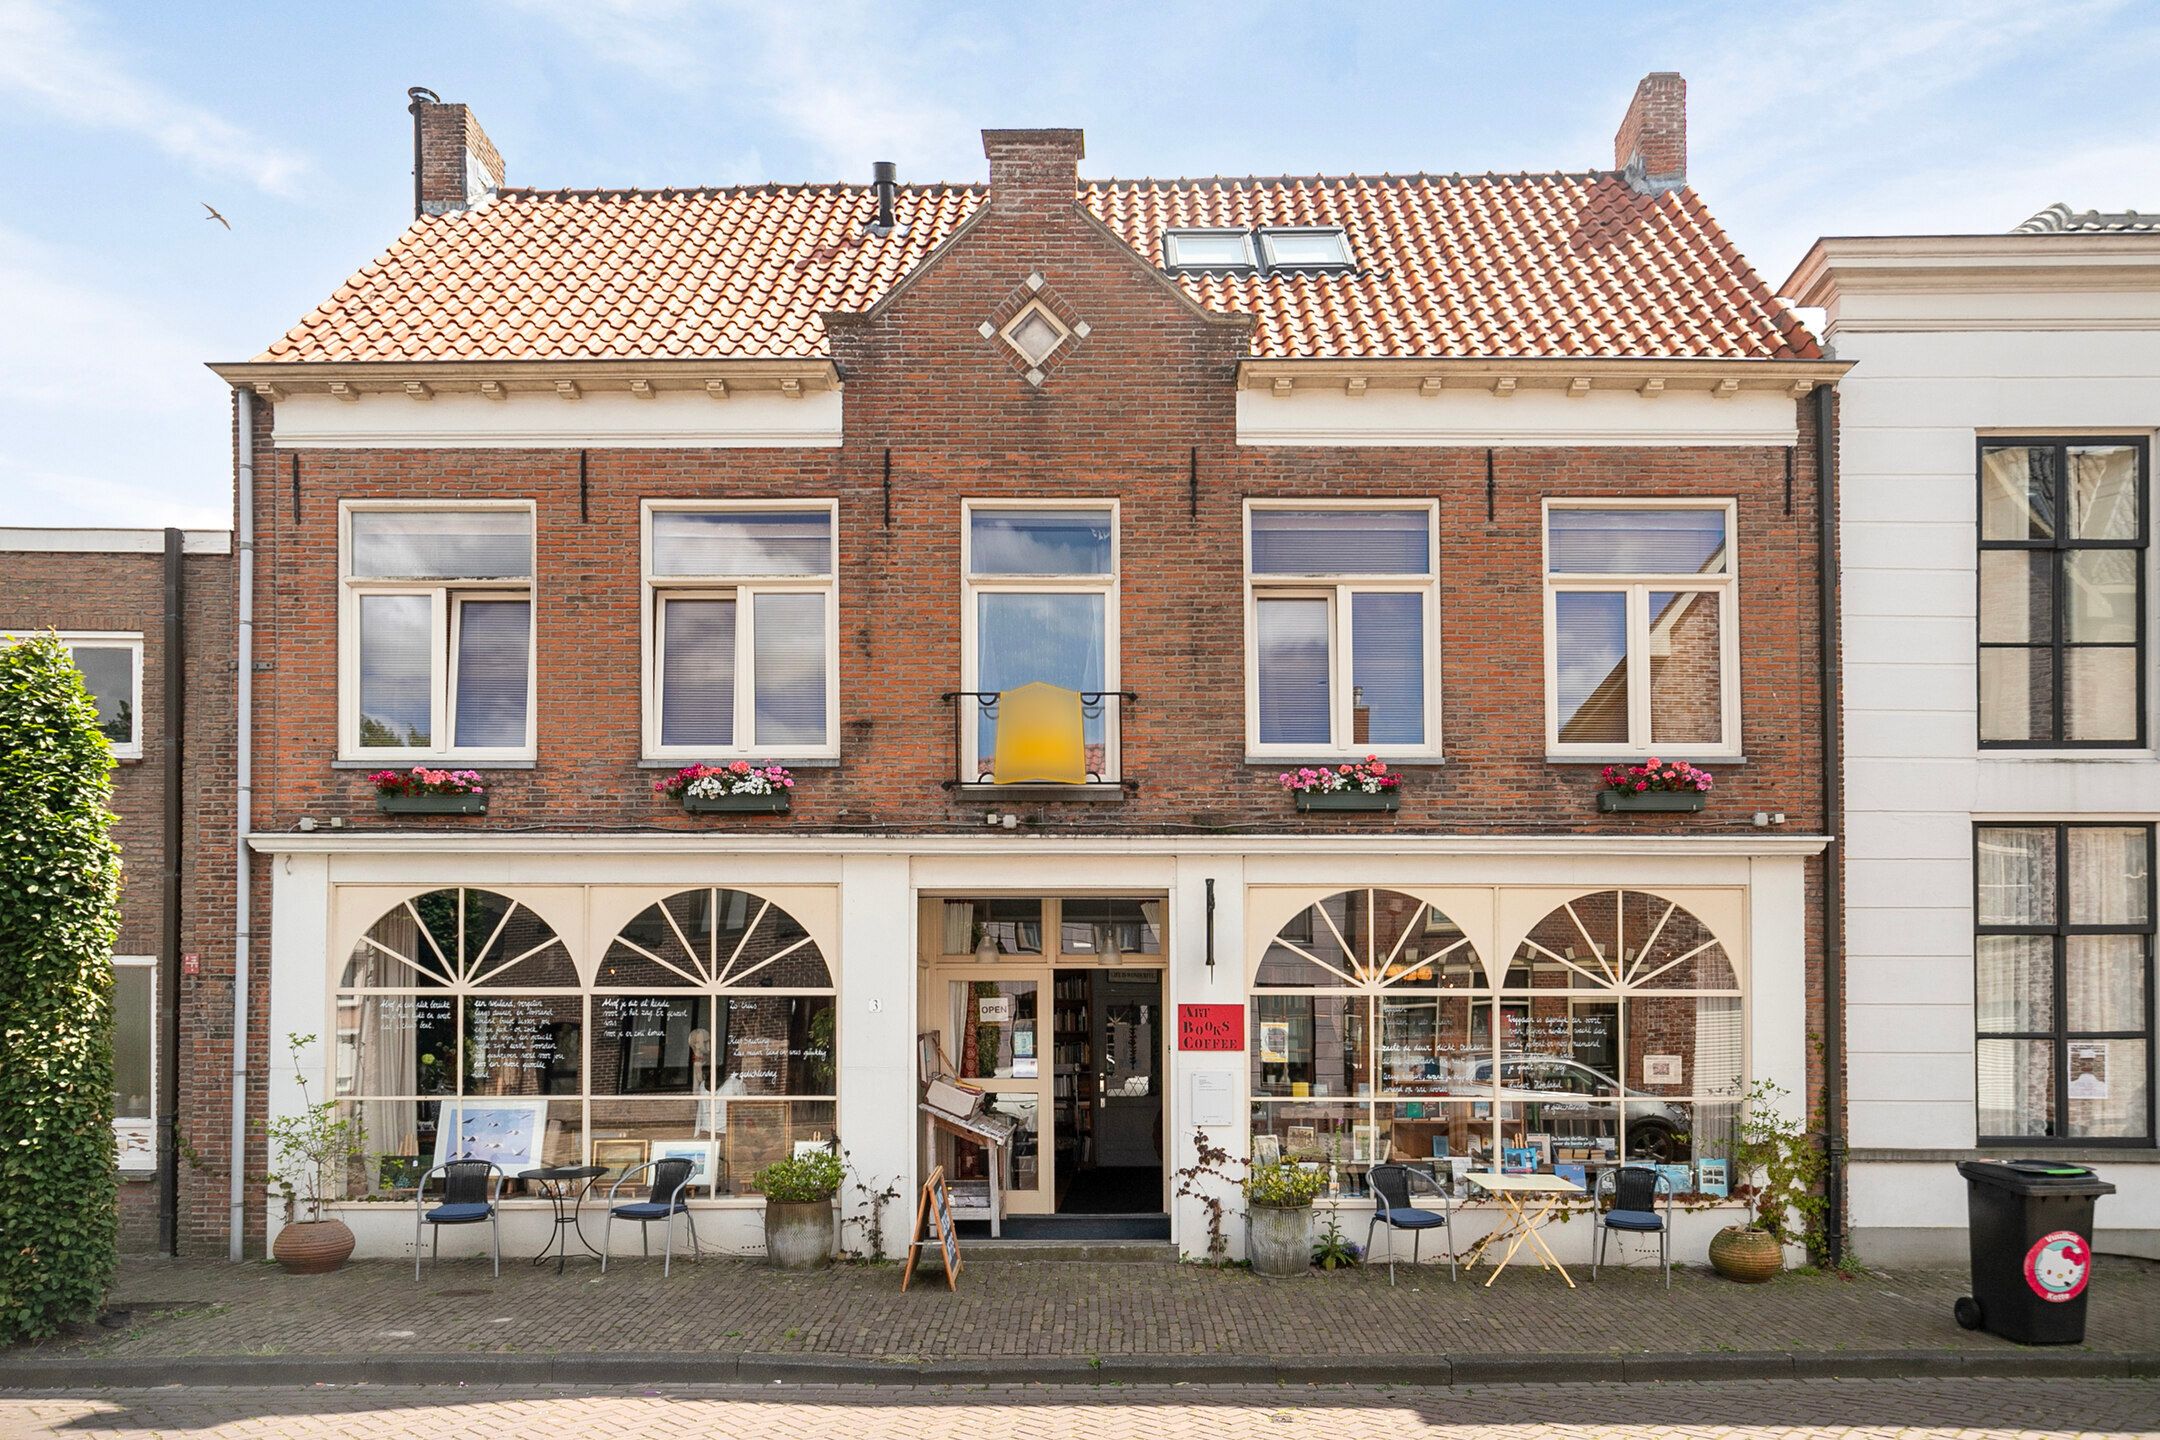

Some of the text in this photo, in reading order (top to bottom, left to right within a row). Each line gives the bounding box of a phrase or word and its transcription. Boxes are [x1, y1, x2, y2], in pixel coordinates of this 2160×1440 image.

[872, 999, 879, 1011] 3
[981, 1005, 1007, 1014] OPEN
[1183, 1006, 1210, 1018] ART
[1184, 1021, 1229, 1036] BOOKS
[1183, 1037, 1238, 1049] COFFEE
